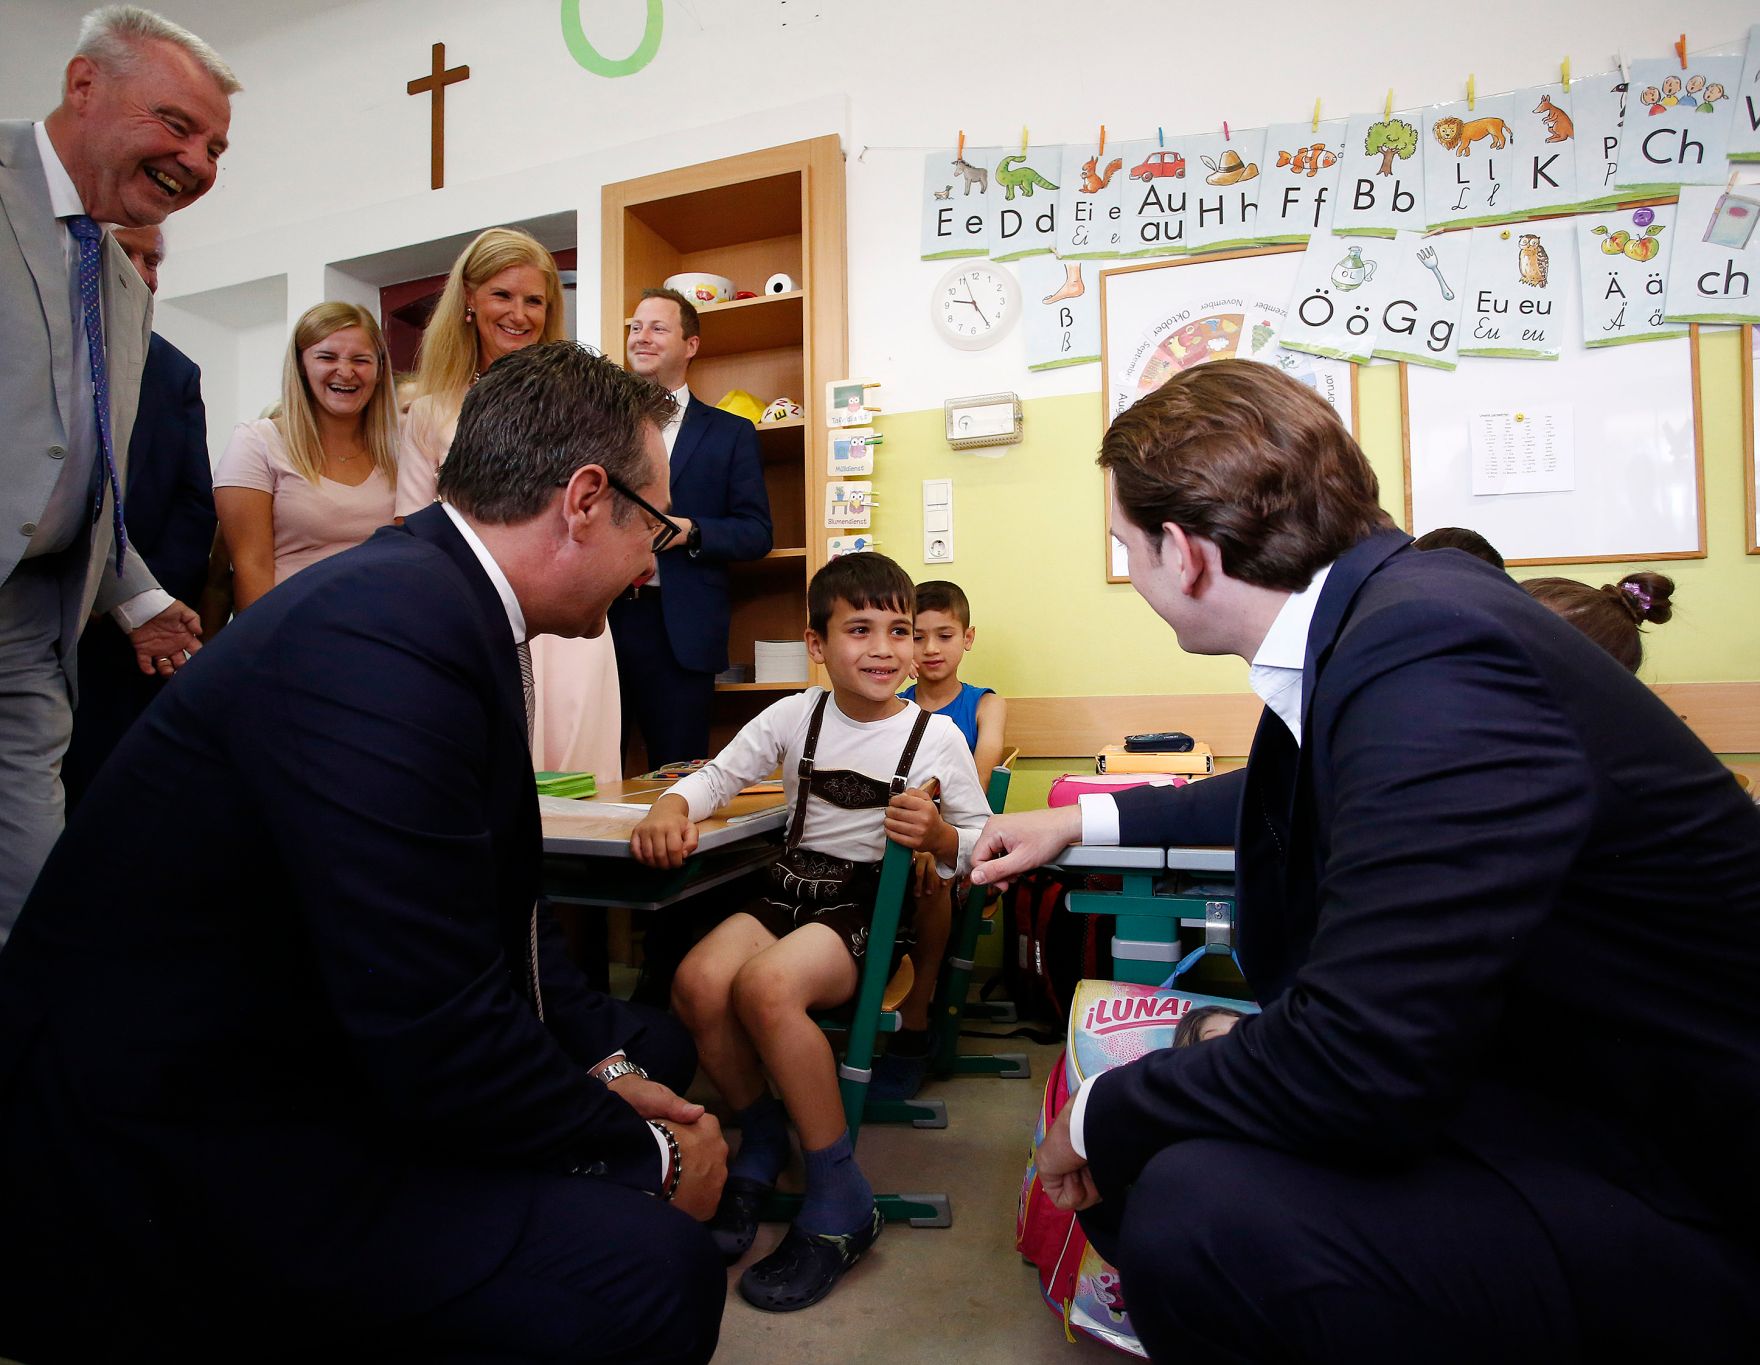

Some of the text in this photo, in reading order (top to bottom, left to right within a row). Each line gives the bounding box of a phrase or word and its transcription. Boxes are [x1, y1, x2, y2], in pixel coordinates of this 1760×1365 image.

[1604, 136, 1618, 159] P
[1642, 128, 1704, 165] Ch
[1456, 158, 1496, 184] L l
[1533, 153, 1560, 189] K
[1604, 162, 1618, 186] P
[1137, 184, 1186, 215] Au
[1199, 192, 1258, 228] H h
[1281, 187, 1329, 228] F f
[1353, 178, 1415, 213] B b
[1451, 187, 1470, 210] L
[938, 207, 983, 237] E e
[1000, 203, 1055, 239] D d
[1075, 201, 1121, 222] Ei e
[1071, 224, 1121, 246] Ei e
[1140, 220, 1183, 242] au
[1604, 271, 1663, 300] Ä ä
[1698, 259, 1750, 296] ch
[1200, 298, 1244, 311] November
[1298, 288, 1370, 336] Ö ö
[1477, 290, 1552, 315] Eu eu
[1602, 301, 1665, 331] Ä ä
[1060, 307, 1074, 328] ß
[1153, 309, 1191, 337] Oktober
[1382, 299, 1455, 352] G g
[1473, 316, 1545, 342] Eu eu
